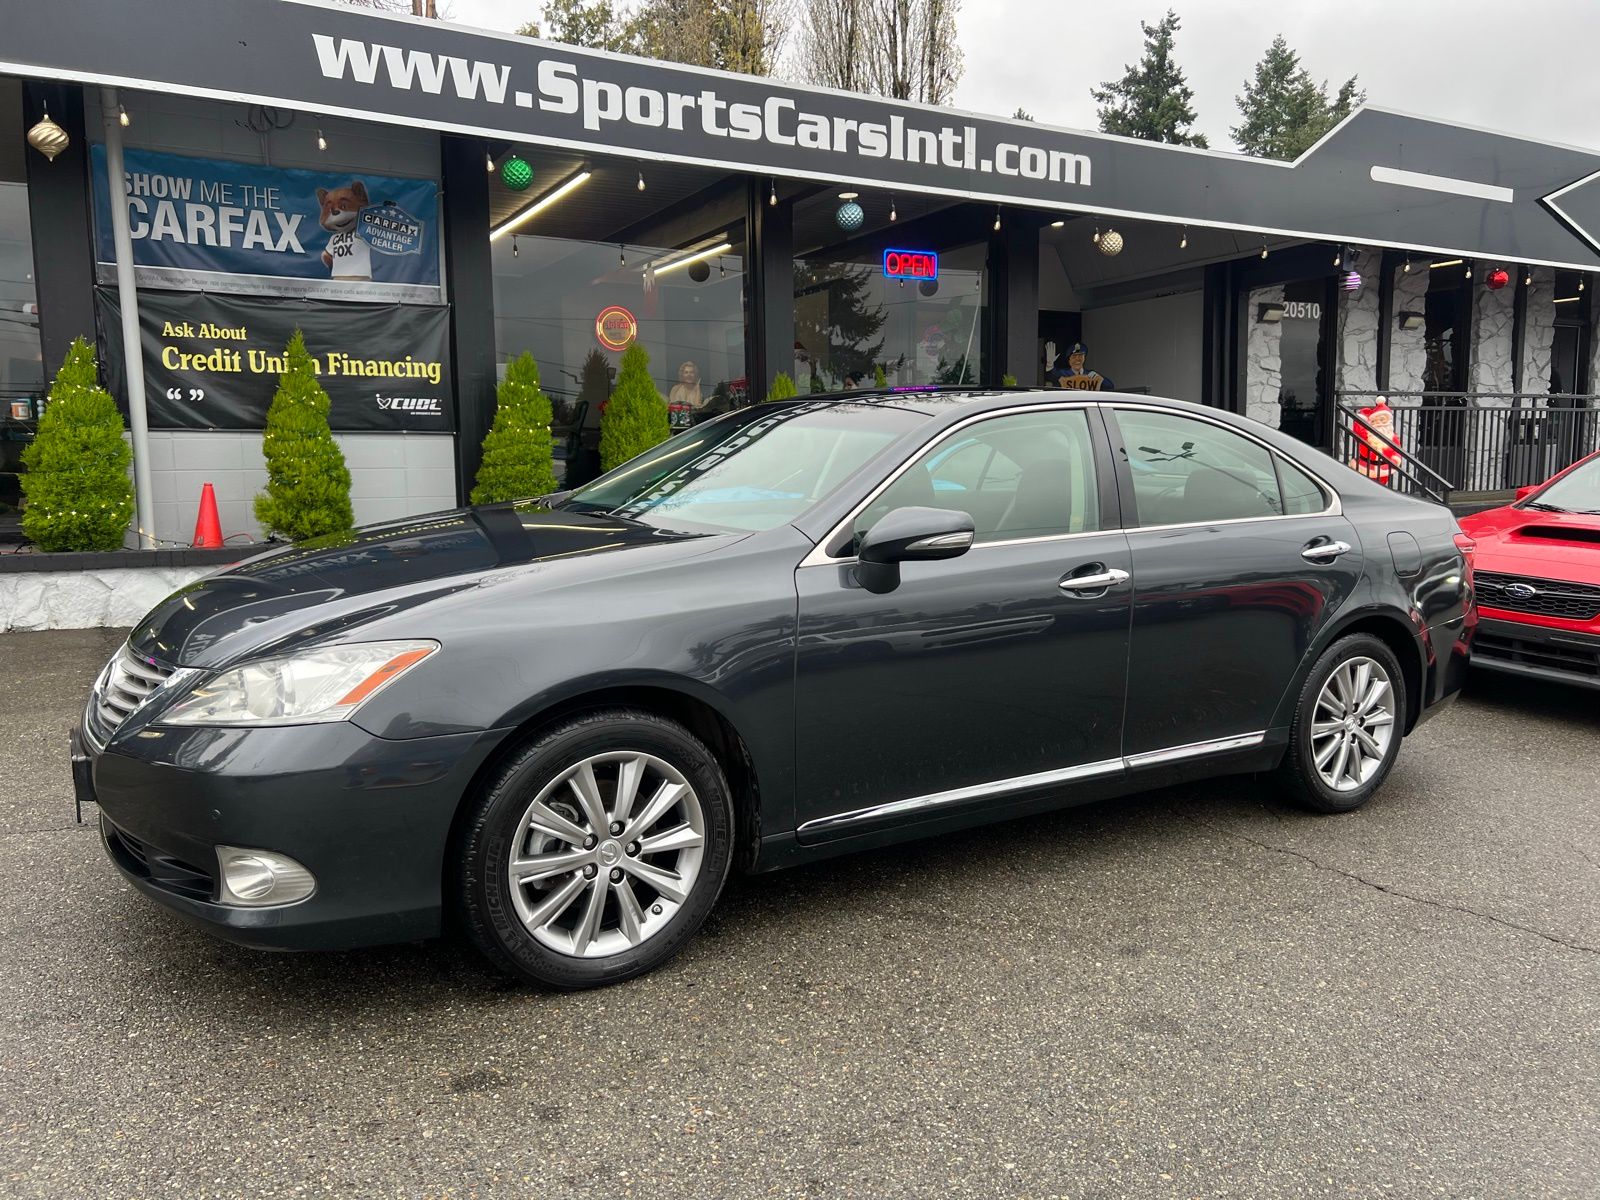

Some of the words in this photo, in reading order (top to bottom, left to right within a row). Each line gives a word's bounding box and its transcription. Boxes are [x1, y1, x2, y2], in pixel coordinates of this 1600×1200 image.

[311, 33, 1092, 187] www.SportsCarsIntl.com
[201, 180, 234, 205] ME
[240, 185, 281, 210] THE
[128, 196, 306, 254] CARFAX
[363, 213, 418, 237] CARFAX
[332, 231, 353, 246] CAR
[365, 225, 413, 245] ADVANTAGE
[371, 236, 403, 252] DEALER
[333, 243, 353, 258] FOX
[887, 252, 935, 277] OPEN
[1283, 301, 1320, 319] 20510
[162, 322, 195, 337] Ask
[198, 323, 247, 340] About
[162, 346, 242, 372] Credit
[247, 350, 321, 375] Unin
[327, 352, 441, 385] Financing
[1066, 380, 1099, 391] SLOW
[390, 397, 442, 410] CUDL
